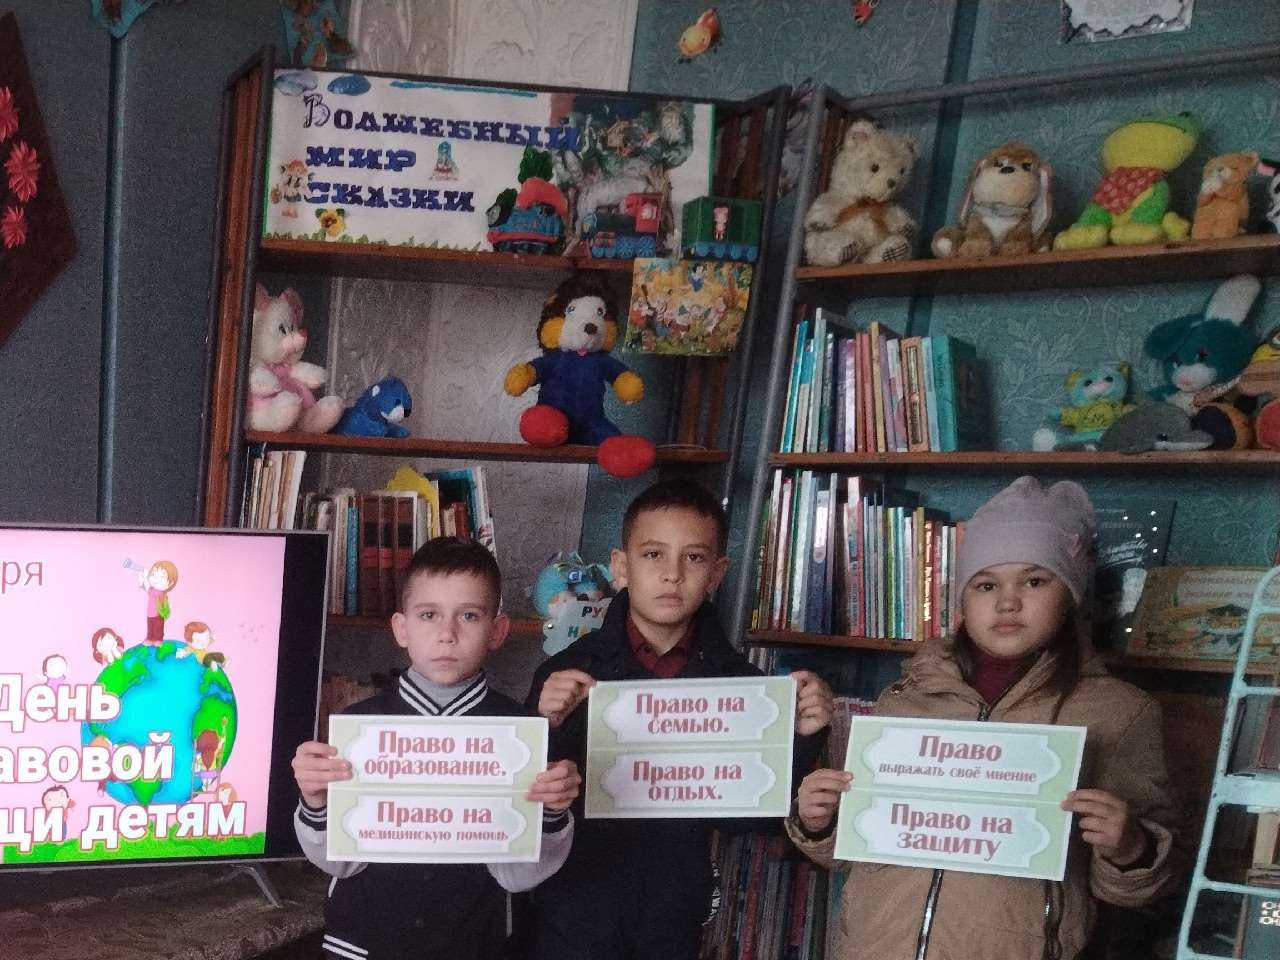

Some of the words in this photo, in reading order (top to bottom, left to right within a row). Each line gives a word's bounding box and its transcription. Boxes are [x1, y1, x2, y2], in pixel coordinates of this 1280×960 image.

[636, 693, 708, 719] Право
[718, 697, 746, 712] на
[648, 717, 729, 734] семью.
[379, 730, 455, 757] Право
[466, 737, 494, 753] на
[919, 735, 1002, 762] Право
[364, 754, 507, 779] образование.
[633, 761, 704, 784] Право
[714, 764, 742, 780] на
[878, 763, 944, 777] выражать
[950, 766, 981, 779] своё
[986, 770, 1037, 783] мнение
[648, 785, 723, 803] отдых.
[80, 802, 246, 850] детям
[377, 801, 453, 827] Право
[463, 807, 492, 824] на
[891, 802, 972, 831] Право
[981, 816, 1012, 834] на
[359, 829, 452, 843] медицинскую
[456, 831, 509, 842] помощь
[897, 832, 1001, 861] защиту
